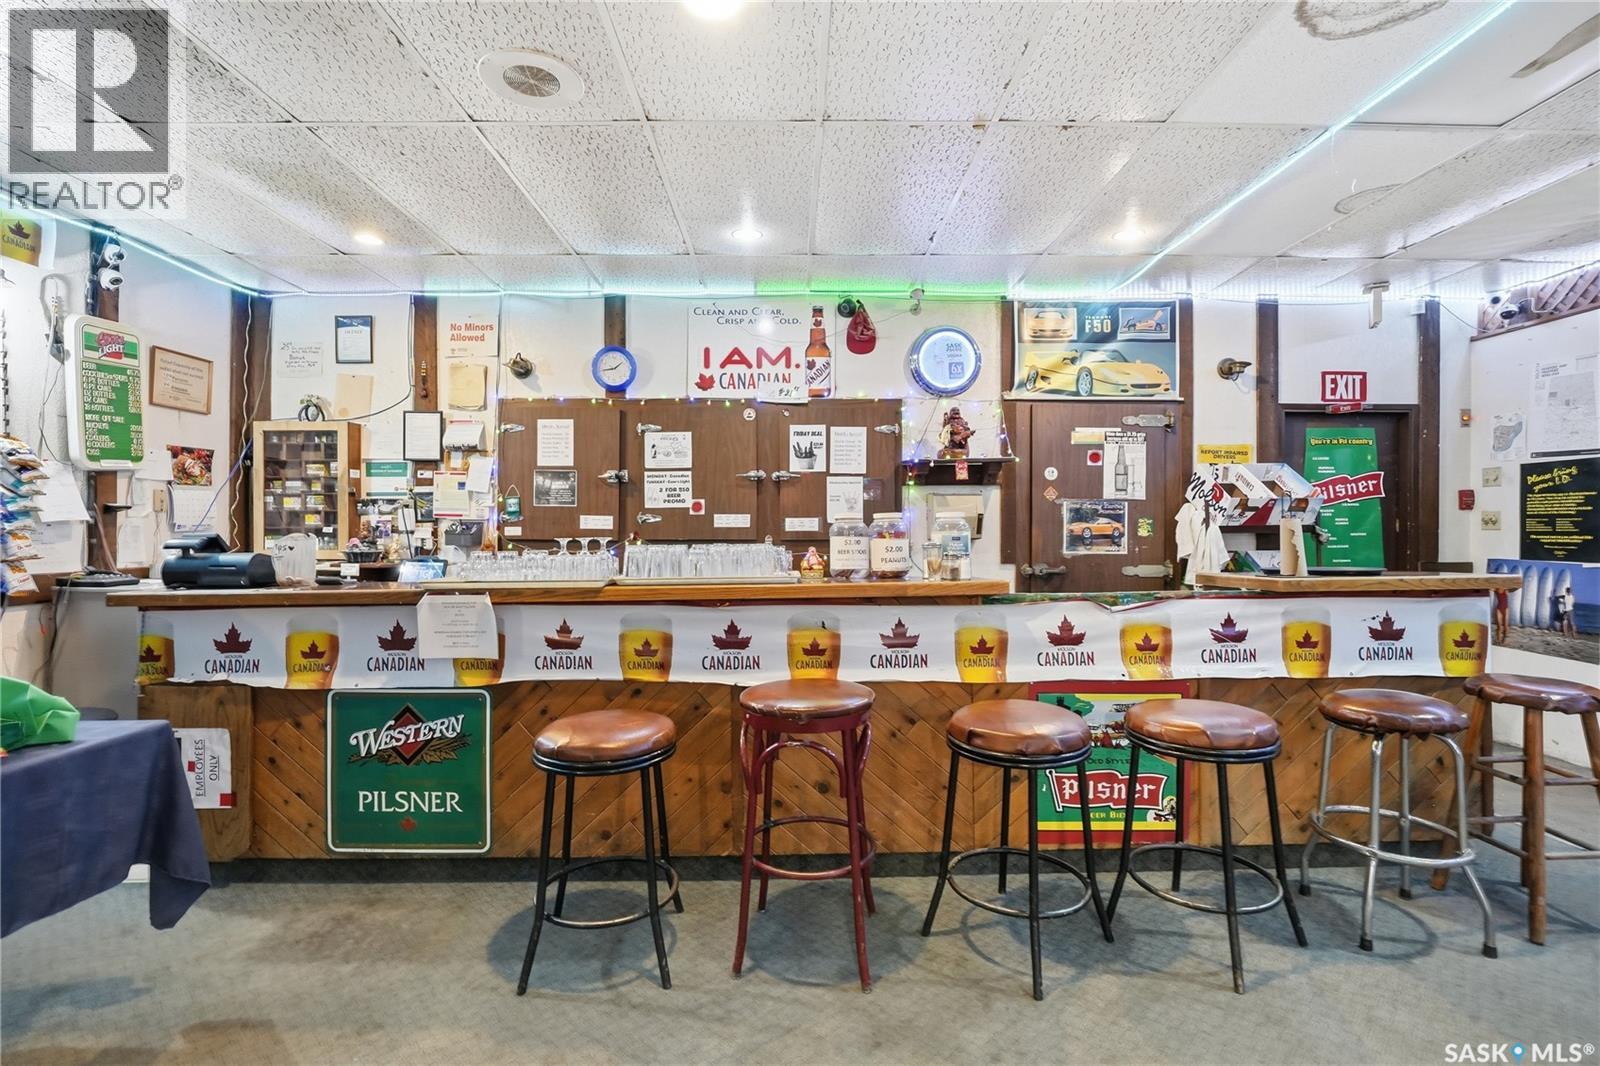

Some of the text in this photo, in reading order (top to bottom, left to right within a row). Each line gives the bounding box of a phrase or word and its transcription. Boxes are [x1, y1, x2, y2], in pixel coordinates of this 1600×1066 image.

[693, 307, 725, 316] CLEAN
[728, 308, 748, 316] AND
[450, 322, 495, 332] No Minors
[716, 316, 745, 325] CRISP
[1085, 320, 1111, 333] F50
[450, 333, 485, 341] Allowed
[98, 344, 124, 354] LIGHT
[704, 347, 711, 369] I
[1325, 374, 1363, 400] EXIT
[1037, 651, 1095, 666] CANADIAN
[1201, 649, 1257, 663] CANADIAN
[1289, 652, 1326, 662] CANADIAN
[1358, 646, 1413, 661] CANADIAN
[204, 659, 260, 674] CANADIAN
[367, 657, 425, 672] CANADIAN
[460, 661, 498, 672] CANADIAN
[534, 655, 593, 670] CANADIAN
[627, 660, 665, 671] CANADIAN
[702, 655, 761, 670] CANADIAN
[796, 659, 833, 670] CANADIAN
[870, 654, 928, 669] CANADIAN
[963, 658, 1000, 668] CANADIAN
[349, 714, 465, 757] WESTERN
[209, 755, 218, 782] ONLY
[358, 791, 463, 812] PILSNER
[1090, 811, 1106, 819] EER
